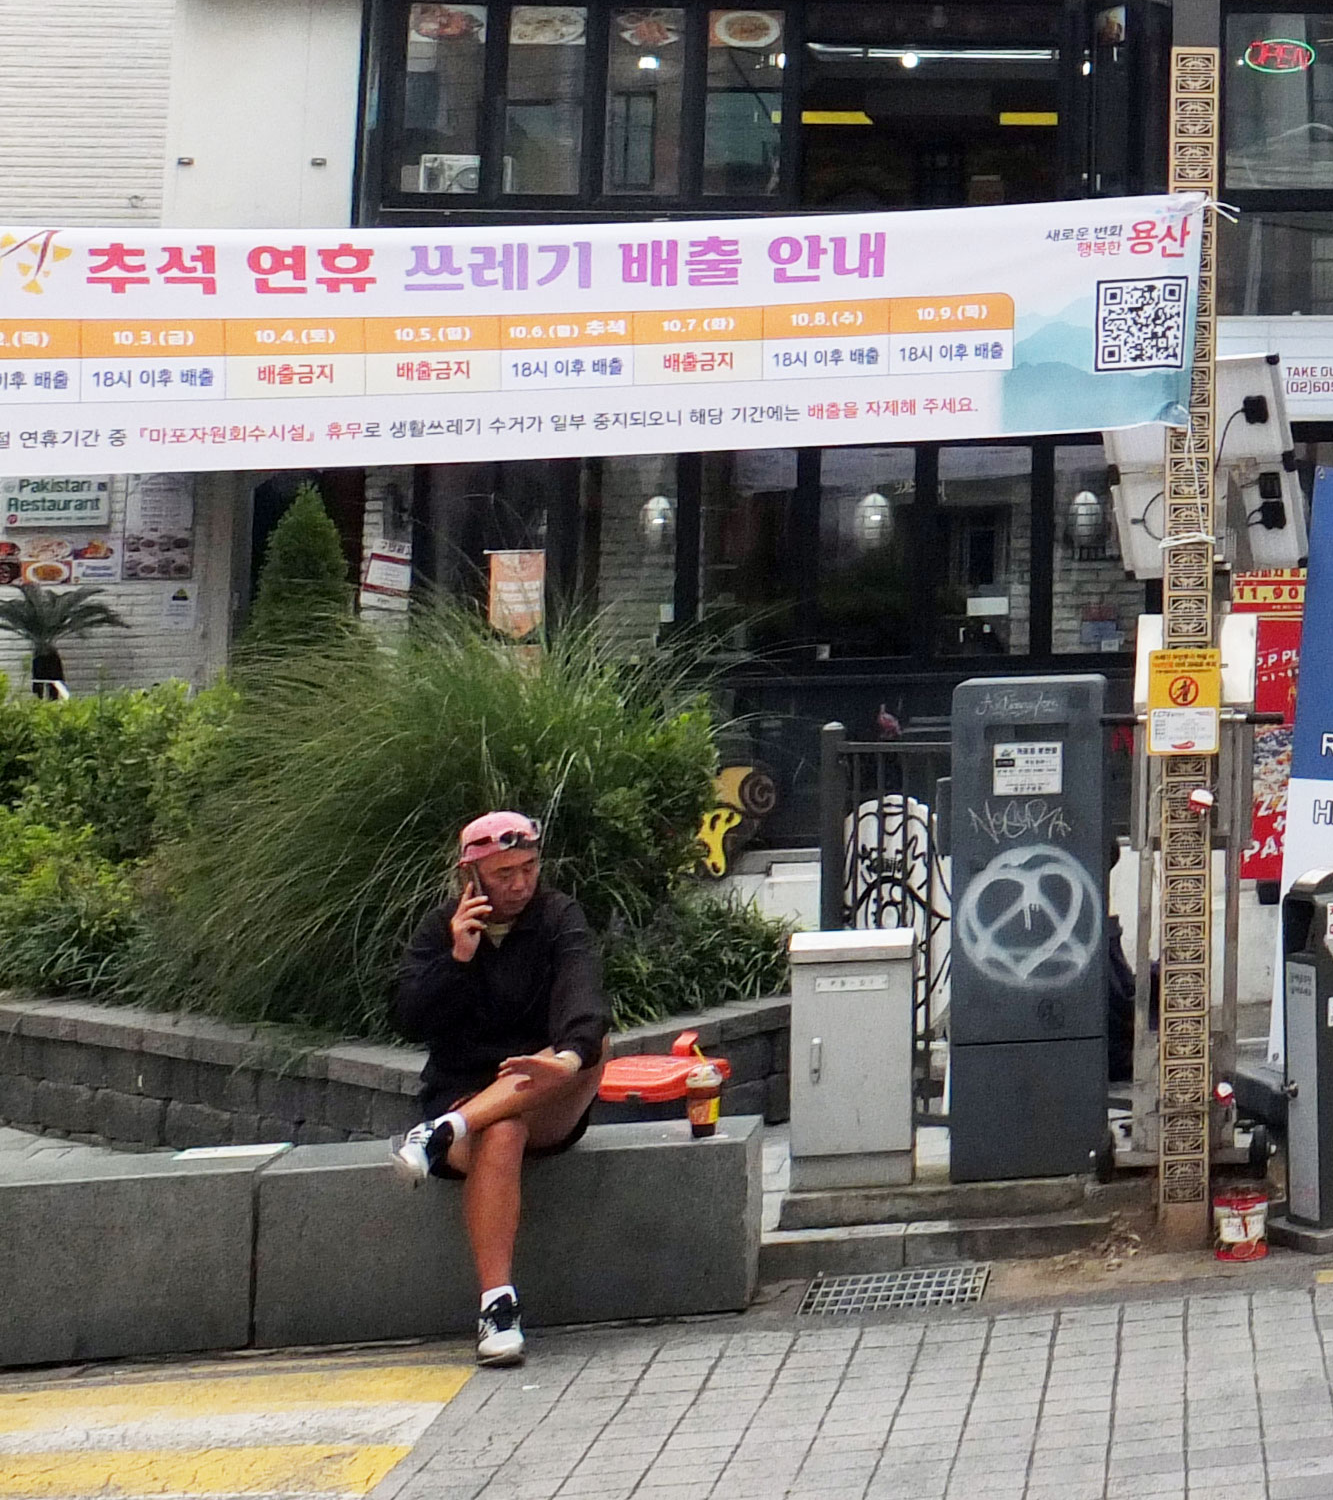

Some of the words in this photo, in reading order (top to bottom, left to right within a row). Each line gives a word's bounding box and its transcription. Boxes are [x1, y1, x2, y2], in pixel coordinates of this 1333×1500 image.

[1044, 226, 1091, 243] 새로운
[1126, 218, 1192, 259] 용산
[86, 243, 218, 296] 추석
[246, 243, 377, 296] 연휴
[404, 241, 593, 292] 쓰레기
[619, 235, 743, 287] 배출
[768, 232, 887, 285] 안내
[663, 351, 735, 373] 배출금지
[773, 351, 808, 368] 18시
[814, 350, 844, 366] 이후
[850, 348, 880, 365] 배출
[899, 345, 933, 362] 18시
[939, 343, 969, 360] 이후
[974, 341, 1004, 359] 배출
[257, 363, 335, 385] 배출금지
[396, 360, 472, 382] 배출금지
[511, 359, 548, 378] 18시
[554, 359, 586, 377] 이후
[592, 357, 624, 376] 배출
[1286, 366, 1318, 378] TAKE
[34, 370, 69, 390] 배출
[92, 369, 132, 389] 18시
[139, 368, 174, 388] 이후
[180, 368, 215, 387] 배출
[19, 429, 101, 449] 연휴기간
[108, 428, 127, 448] 중
[325, 421, 382, 440] 휴무로
[389, 417, 482, 438] 생활쓰레기
[488, 415, 543, 435] 수거가
[549, 413, 587, 432] 일부
[593, 408, 682, 430] 중지되오니
[689, 407, 723, 425] 해당
[730, 404, 801, 423] 기간에는
[807, 401, 859, 420] 배출을
[865, 398, 917, 417] 자제해
[922, 396, 979, 414] 주세요.
[19, 478, 92, 494] Pakistan
